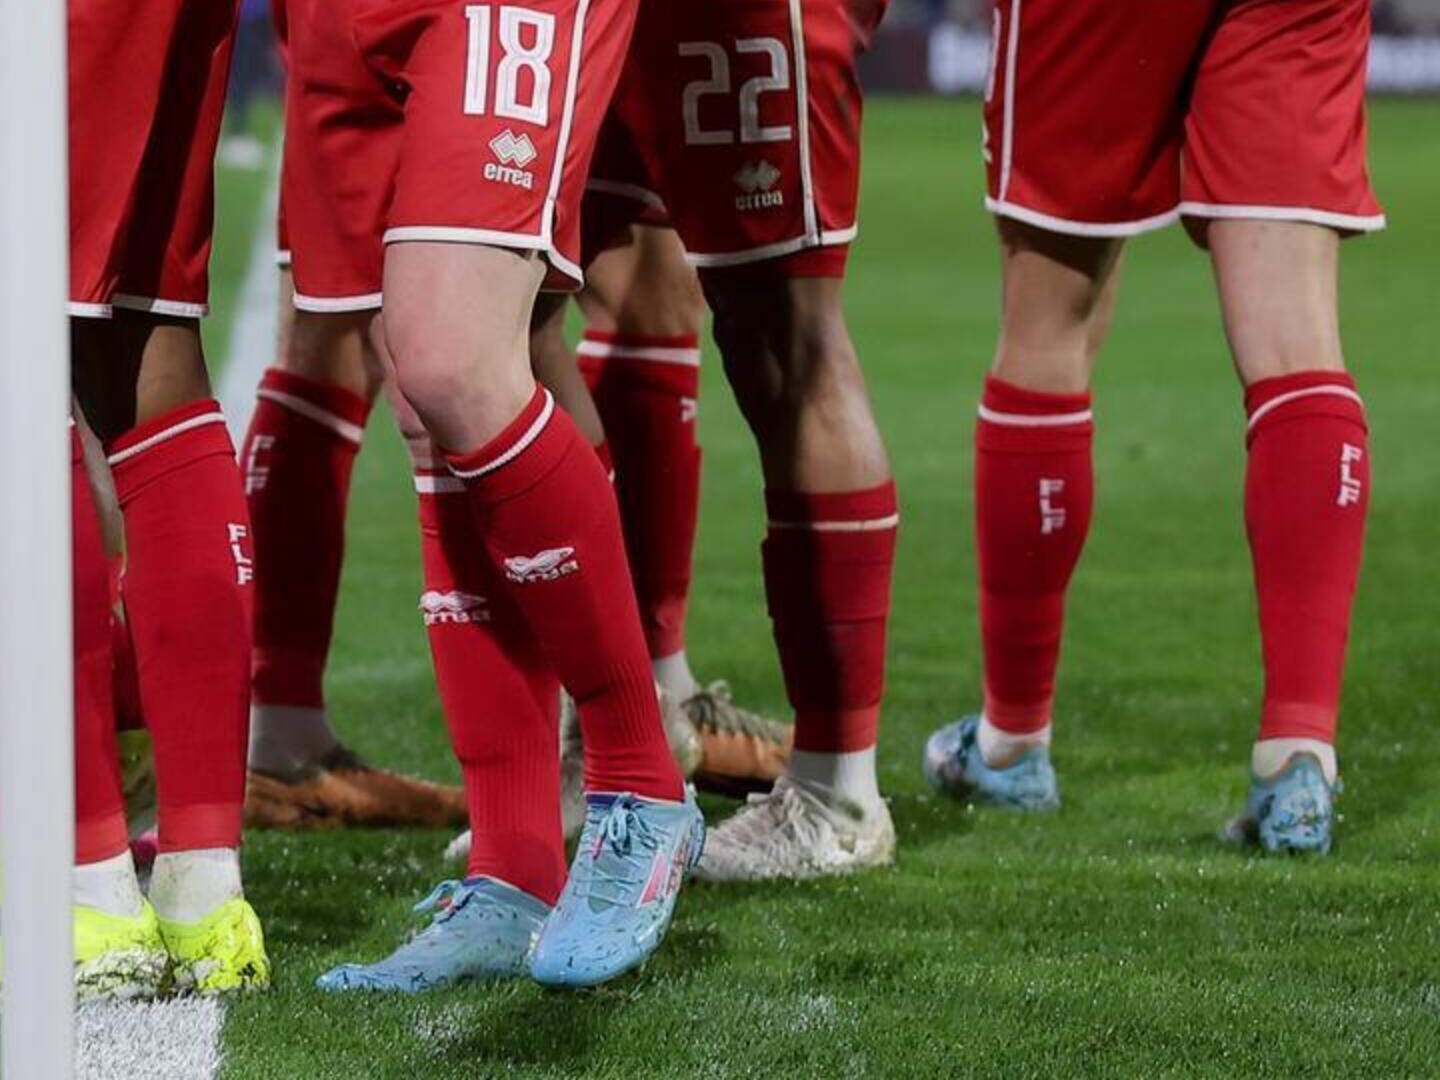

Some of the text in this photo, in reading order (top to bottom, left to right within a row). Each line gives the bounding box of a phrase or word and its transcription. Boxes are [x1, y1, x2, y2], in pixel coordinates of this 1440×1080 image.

[463, 4, 556, 127] 18
[677, 36, 793, 146] 22
[483, 162, 534, 190] errea
[1039, 477, 1066, 535] FLF
[1336, 442, 1363, 508] FLF
[227, 523, 253, 585] FLF
